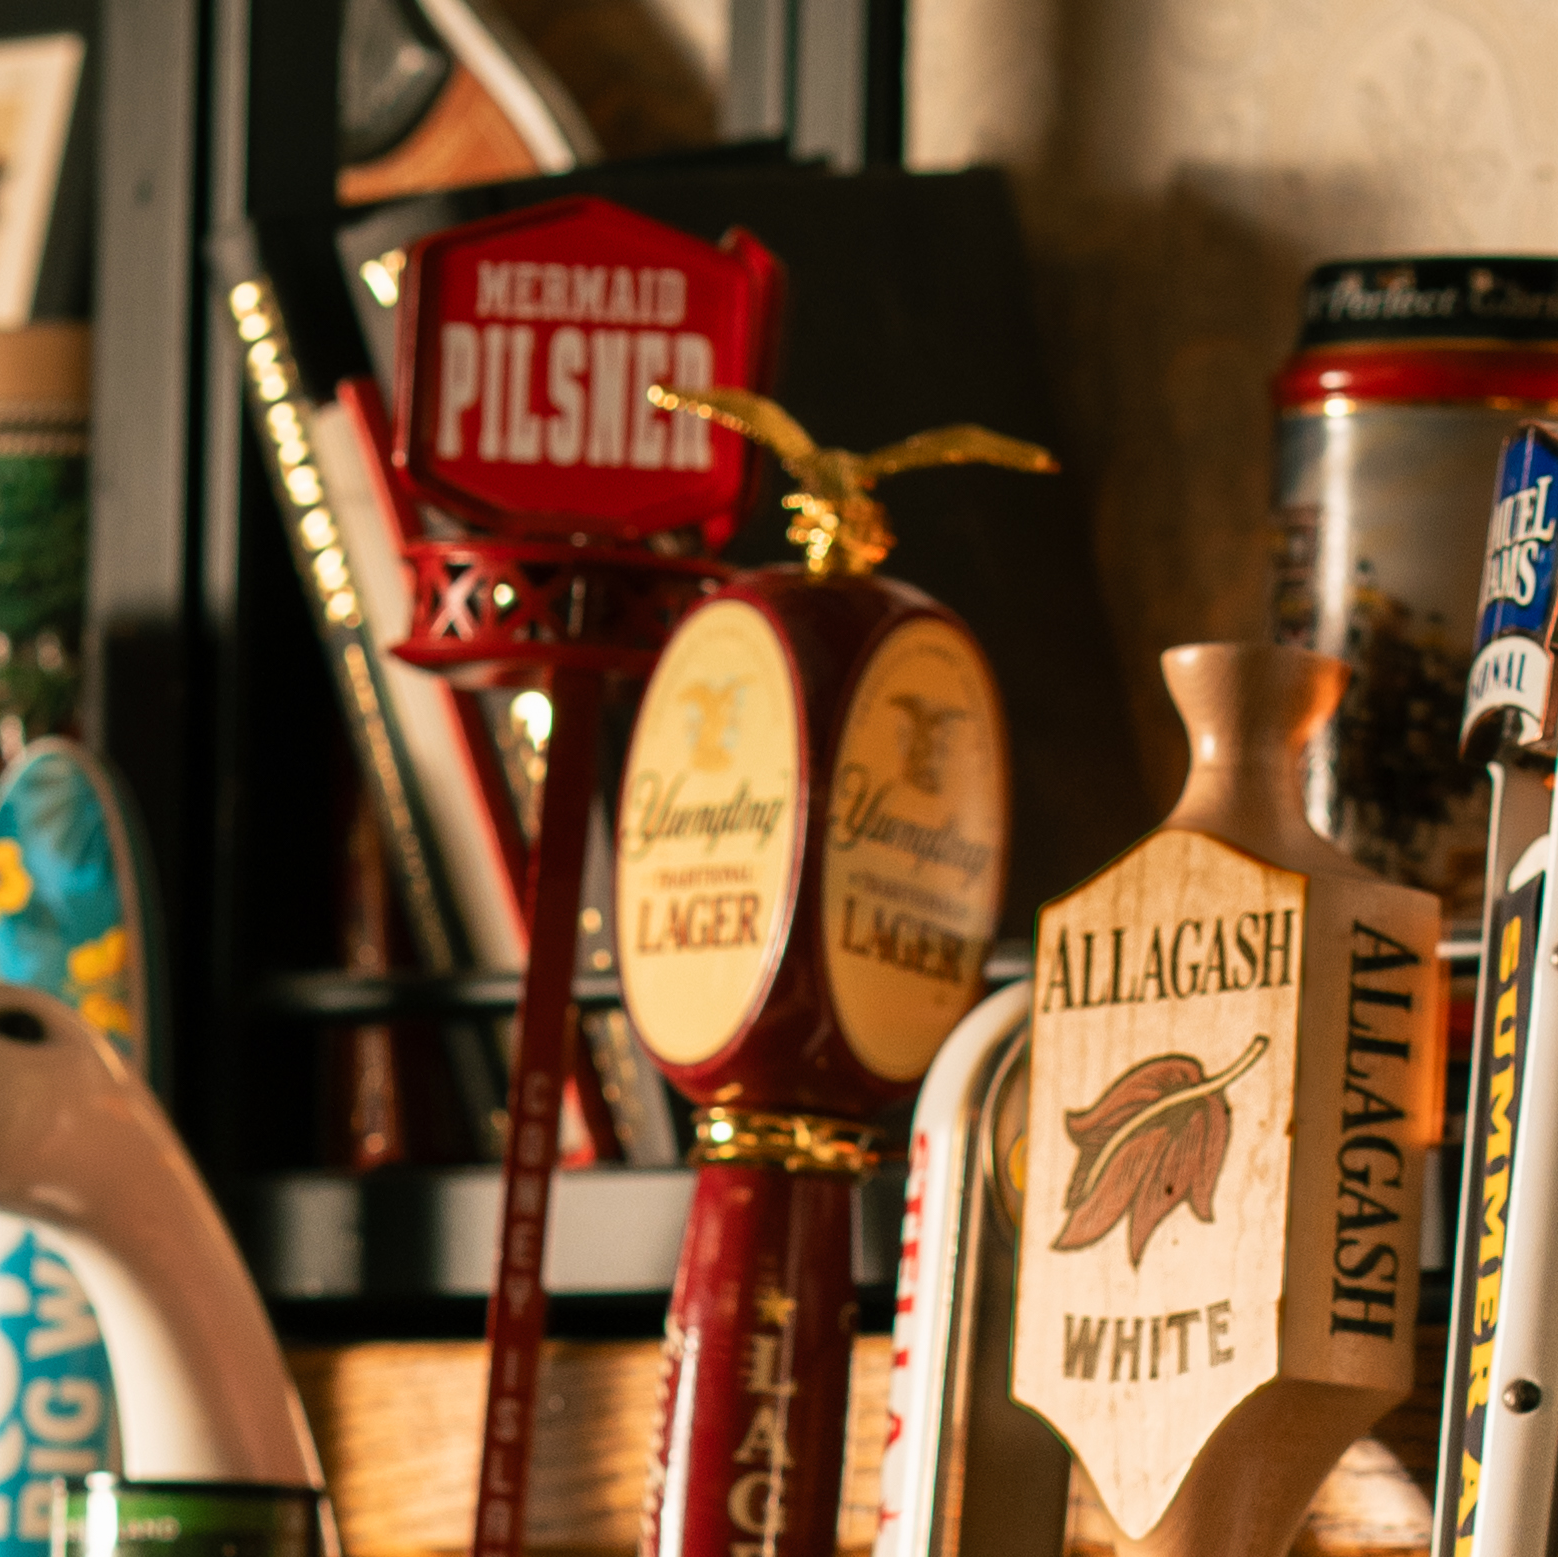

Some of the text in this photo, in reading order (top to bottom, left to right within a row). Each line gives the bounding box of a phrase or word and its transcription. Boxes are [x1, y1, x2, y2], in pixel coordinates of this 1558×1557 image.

[476, 260, 687, 326] MERMAID
[437, 321, 714, 472] PILSNER
[619, 767, 791, 860] Yuengling
[636, 892, 762, 957] LAGER
[842, 895, 965, 984] LAGER
[1043, 909, 1295, 1013] ALLAGASH
[1330, 919, 1423, 1341] ALLAGASH
